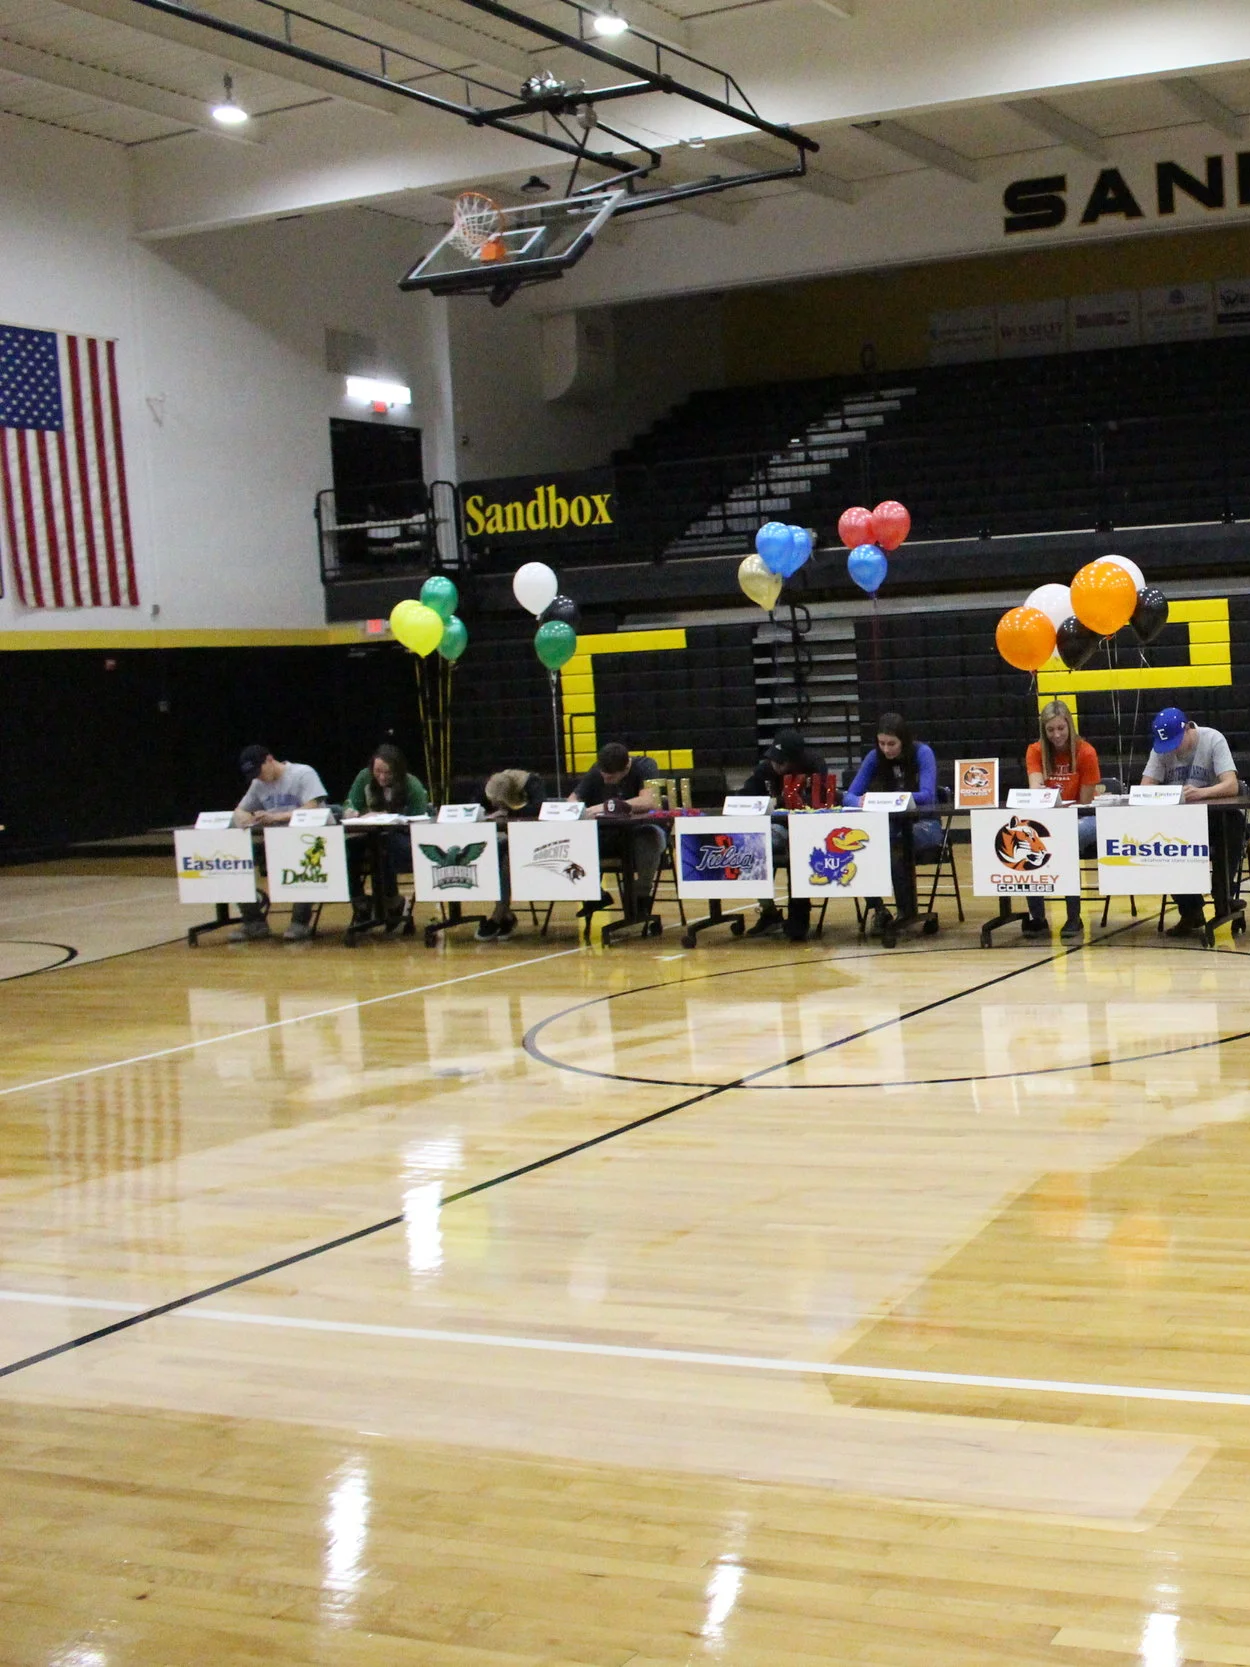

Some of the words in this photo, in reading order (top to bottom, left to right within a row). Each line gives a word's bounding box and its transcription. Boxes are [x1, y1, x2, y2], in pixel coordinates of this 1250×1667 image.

[465, 484, 614, 537] Sandbox
[1157, 728, 1169, 741] E
[1106, 839, 1209, 857] Eastern
[183, 856, 254, 871] Eastern
[823, 856, 841, 869] KU
[990, 873, 1060, 885] COWLEY
[997, 884, 1054, 892] COLLEGE
